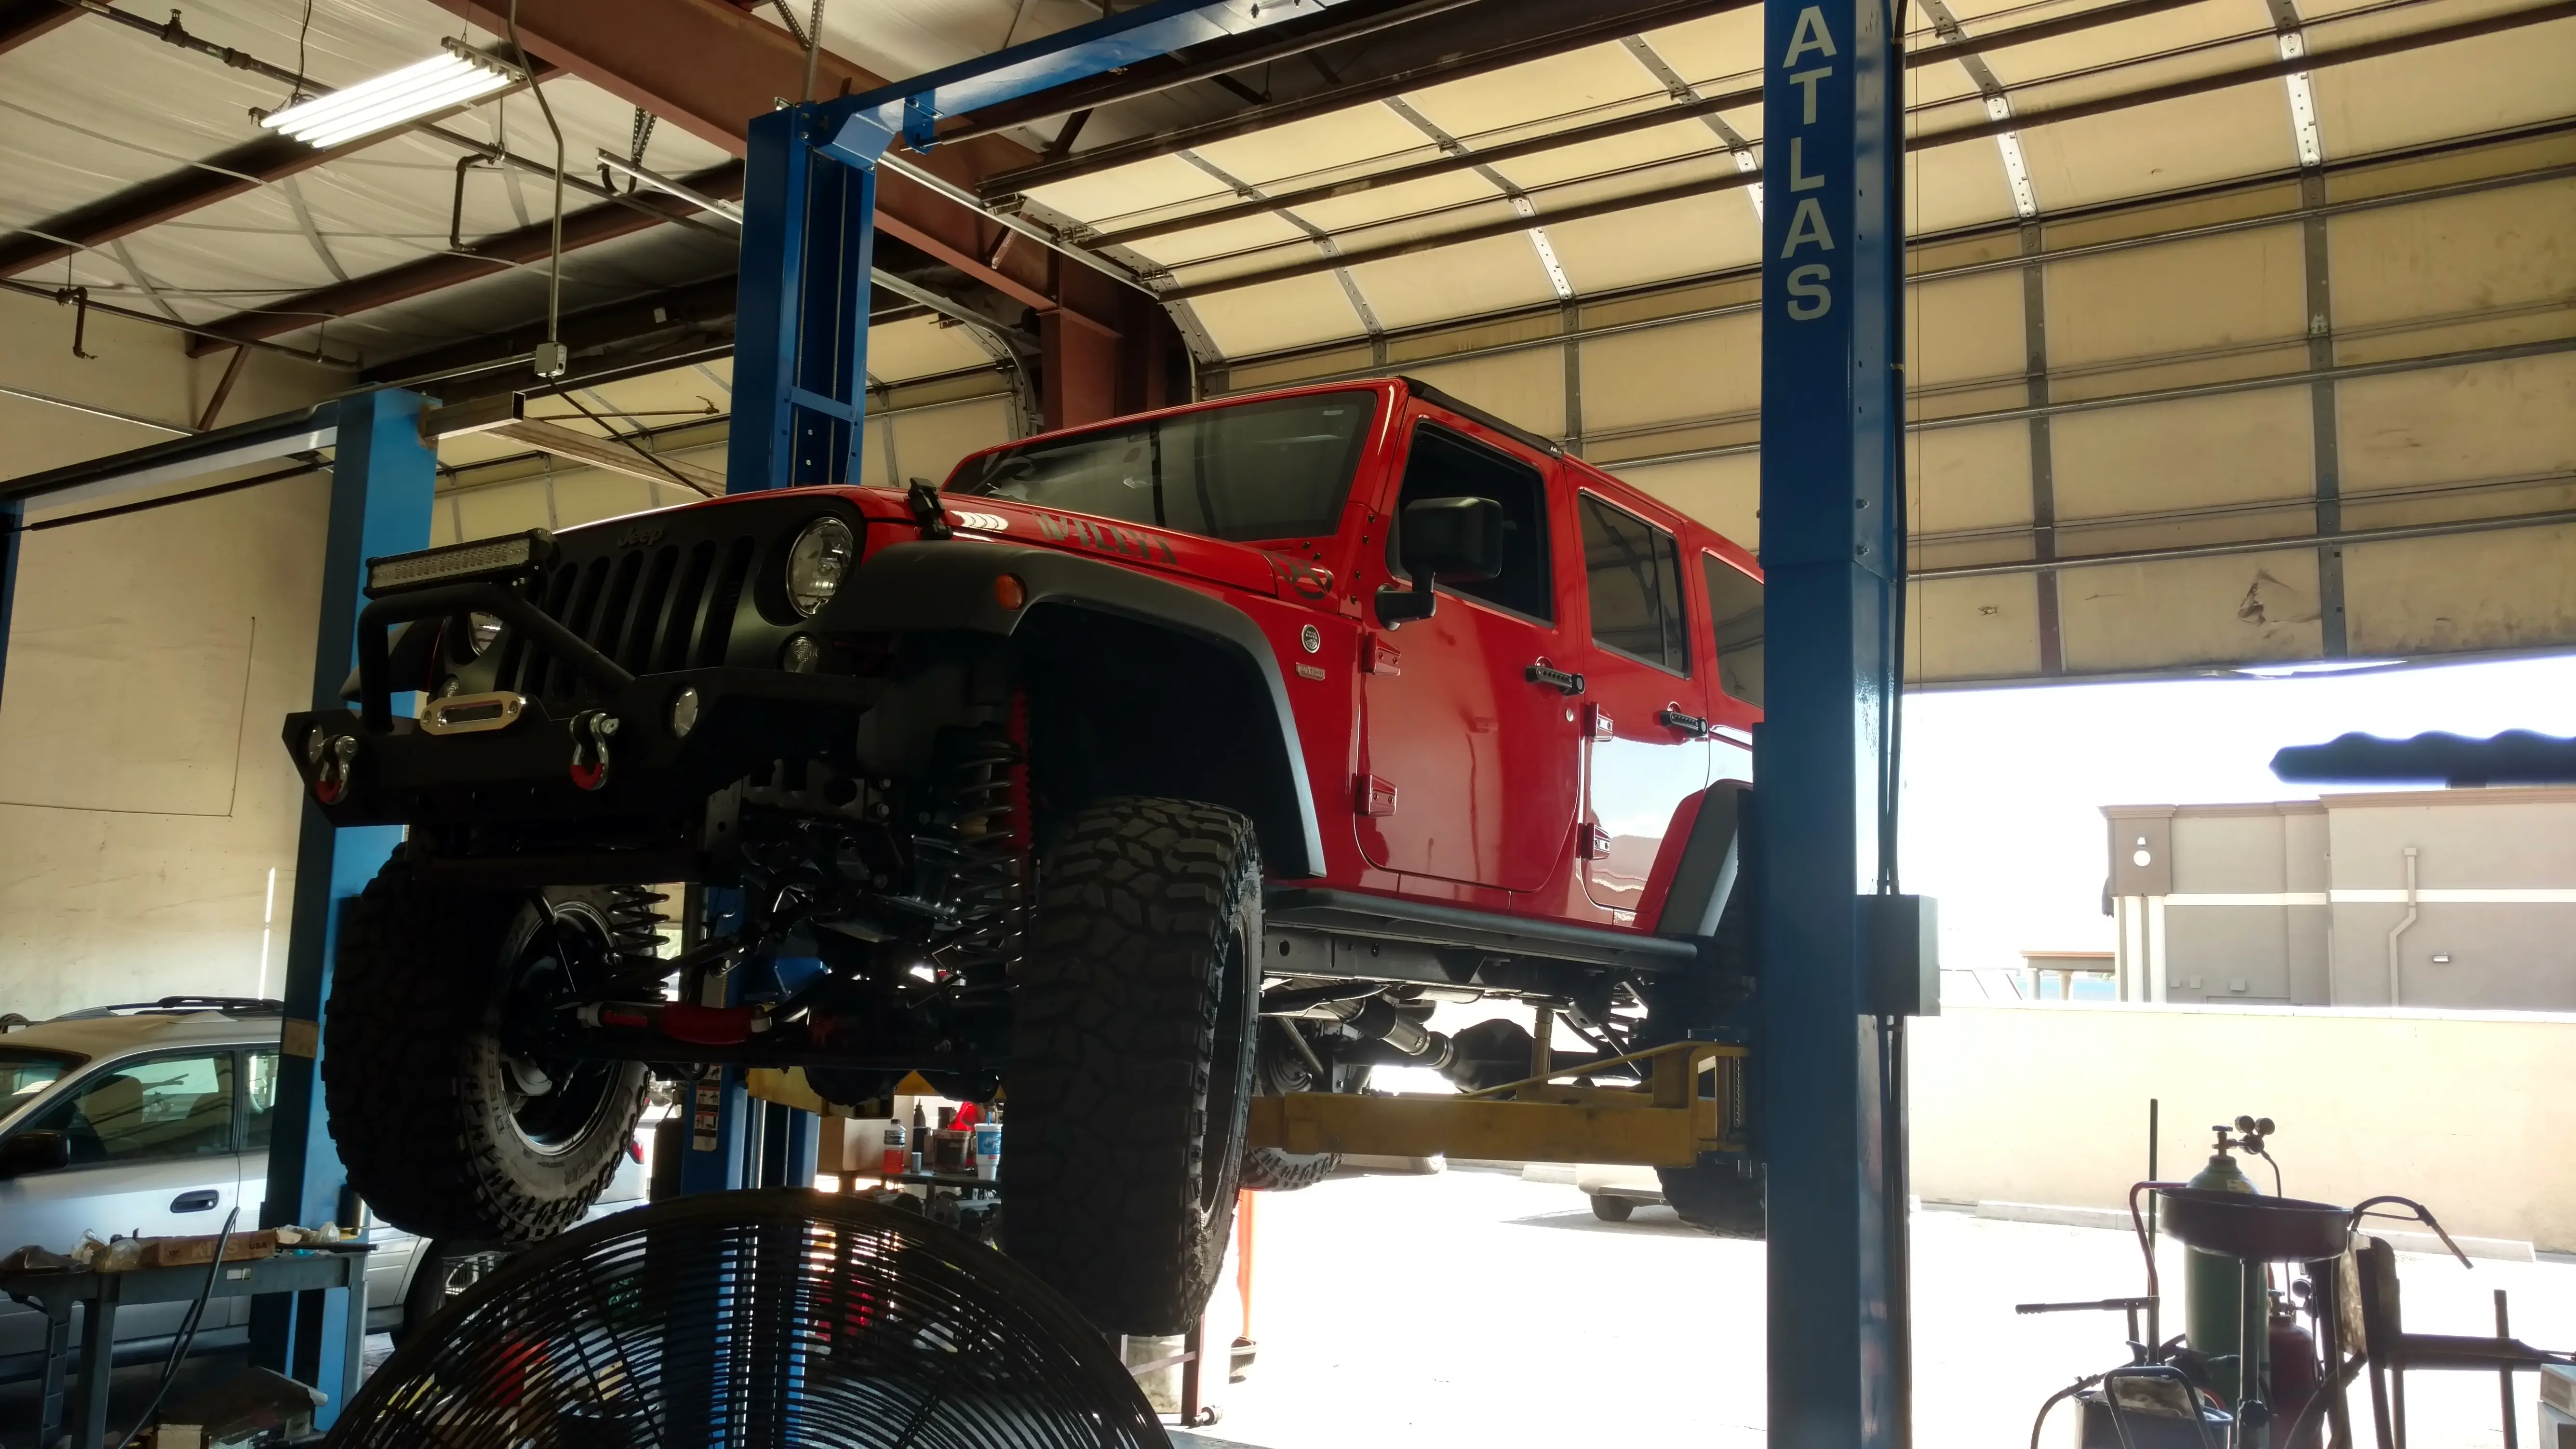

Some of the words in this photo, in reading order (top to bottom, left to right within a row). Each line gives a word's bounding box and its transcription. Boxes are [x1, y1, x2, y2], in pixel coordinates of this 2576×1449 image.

[1780, 5, 1837, 321] ATLAS
[617, 526, 664, 547] Jeep
[1031, 512, 1177, 564] WILLYS
[192, 1238, 239, 1258] KIS
